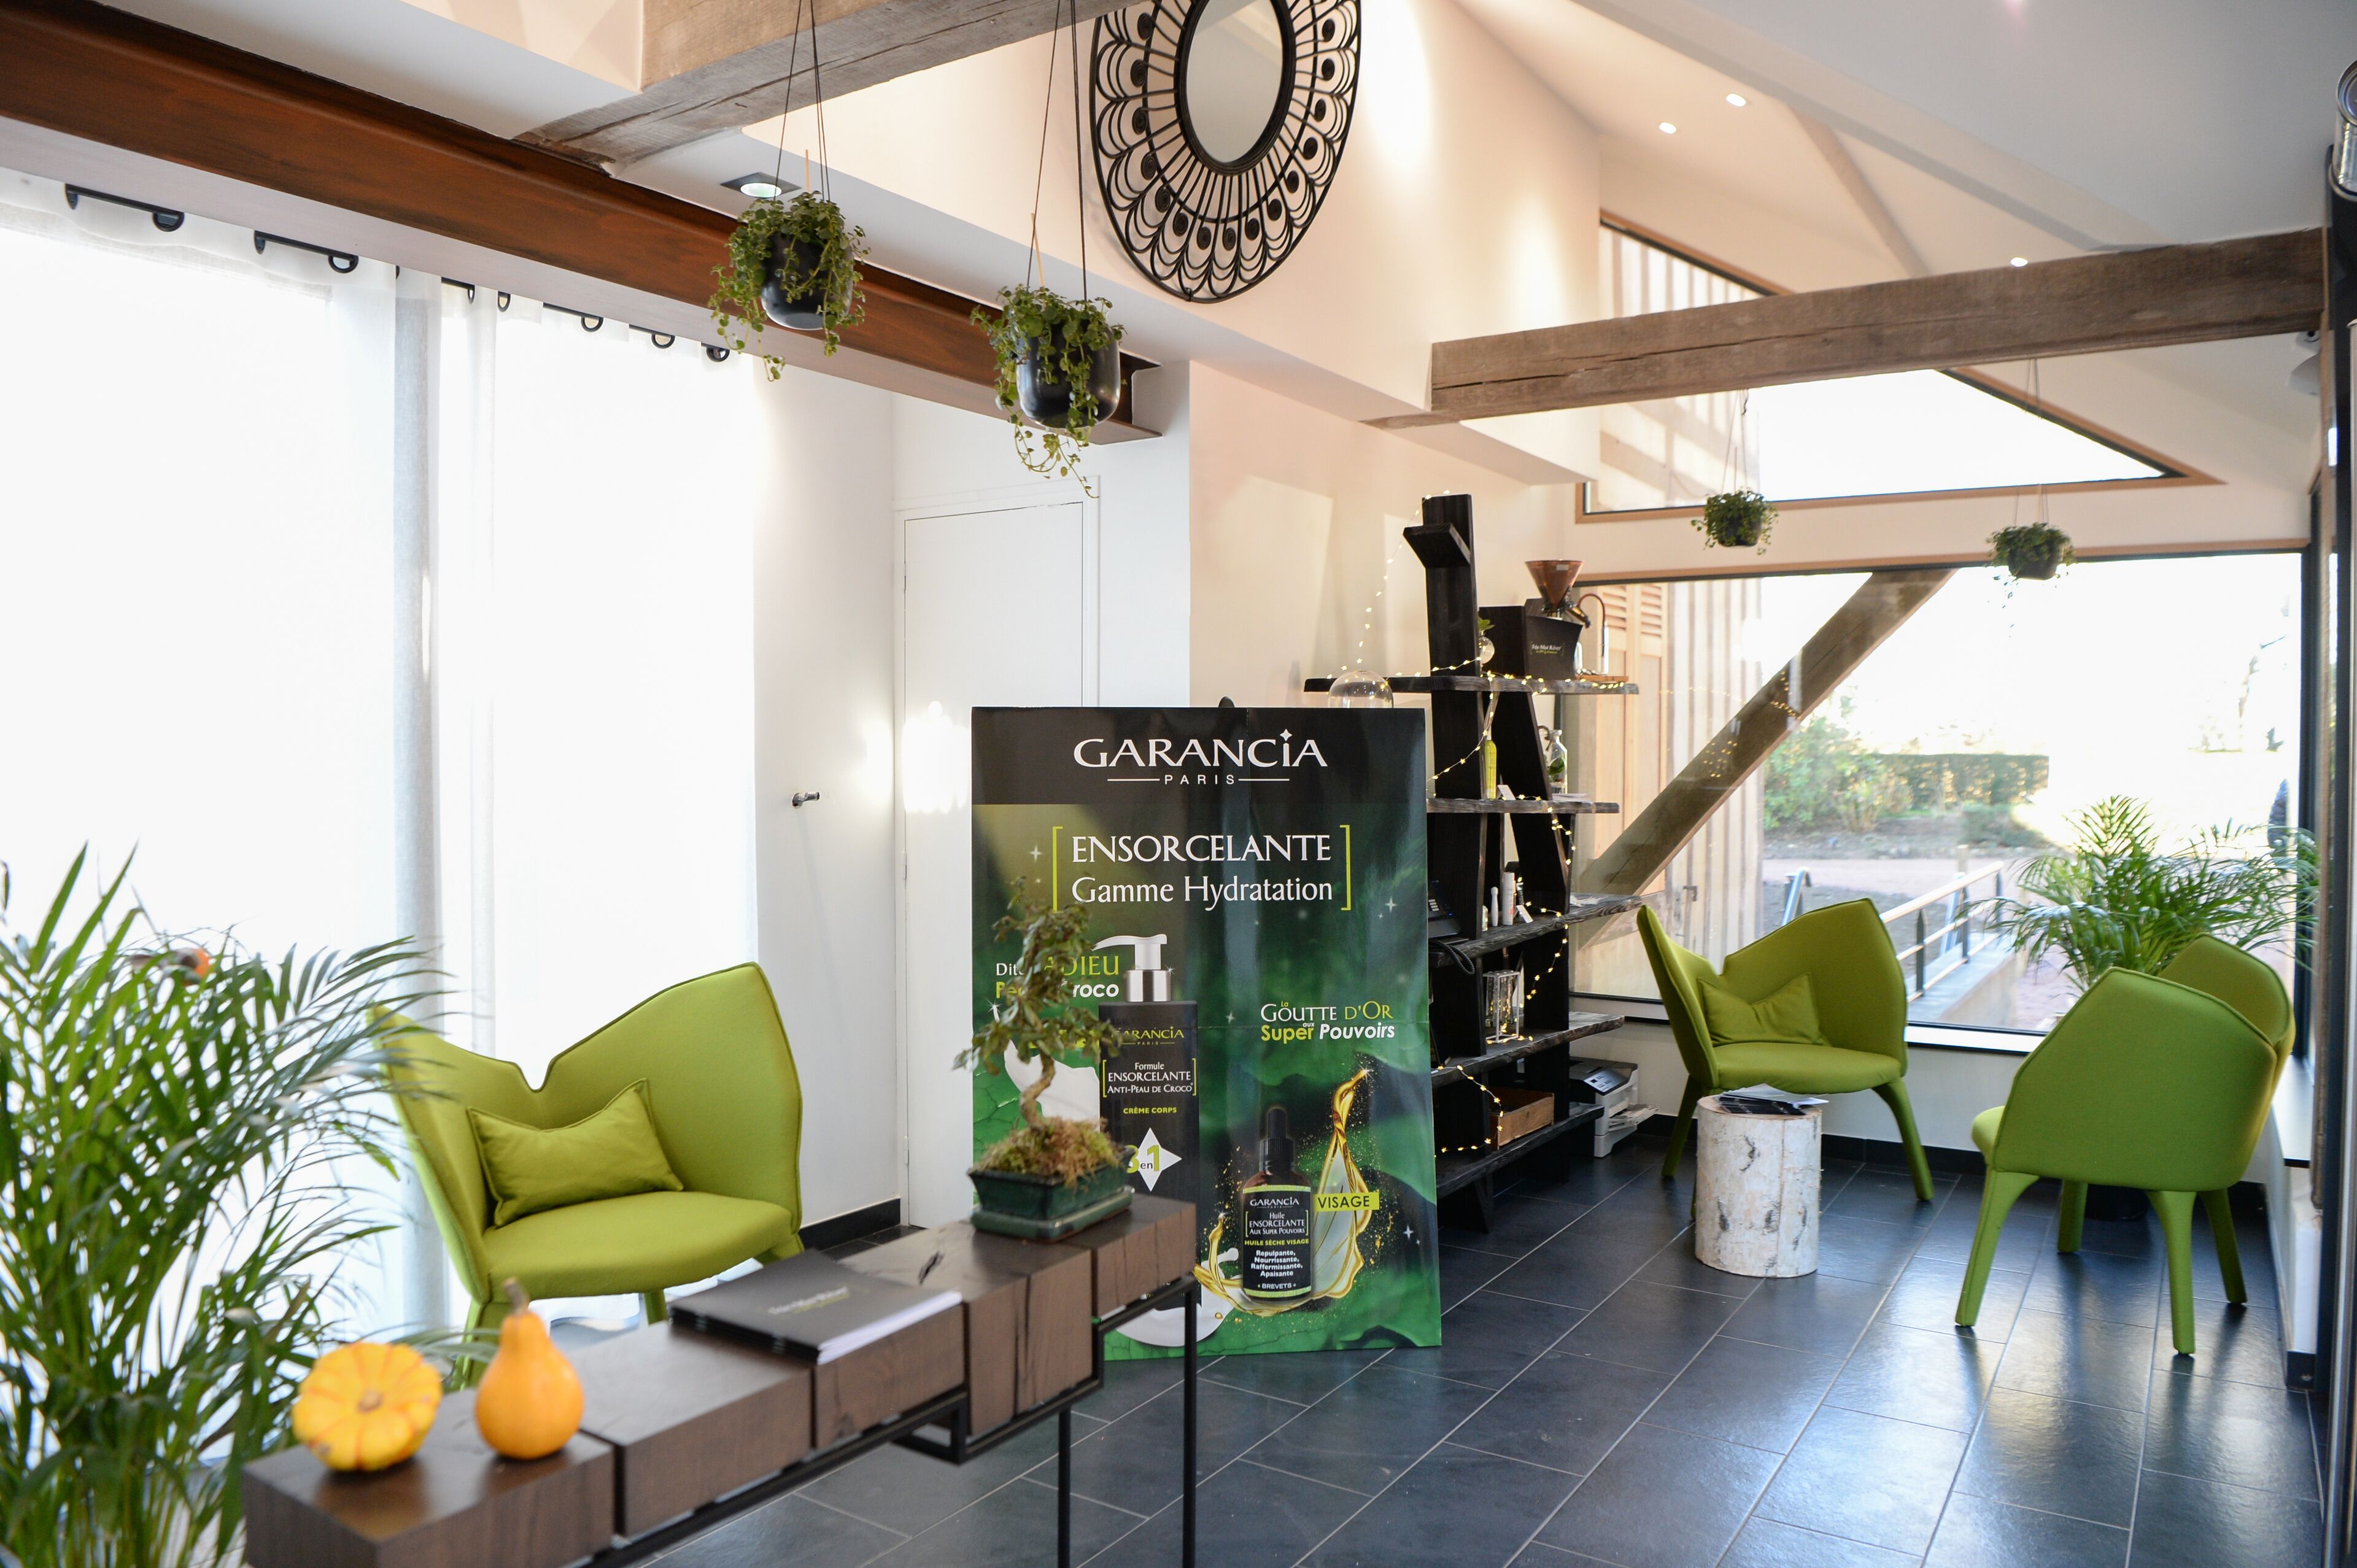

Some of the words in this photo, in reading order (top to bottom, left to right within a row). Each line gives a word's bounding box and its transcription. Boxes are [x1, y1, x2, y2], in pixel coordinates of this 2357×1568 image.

[1164, 774, 1234, 785] PARIS
[1072, 834, 1331, 863] ENSORCELANTE
[1072, 876, 1174, 903] Gamme
[1184, 875, 1333, 911] Hydratation
[996, 962, 1026, 976] Dit
[1061, 980, 1119, 998] roco
[1261, 1003, 1337, 1022] GOUTTE
[1344, 1000, 1393, 1020] D'OR
[1261, 1024, 1314, 1044] Super
[1320, 1022, 1395, 1040] Pouvoirs
[1135, 1062, 1164, 1070] Formule
[1108, 1071, 1191, 1082] ENSORCELANTE
[1317, 1195, 1369, 1208] VISAGE
[1249, 1219, 1305, 1228] ENSORCELANTE
